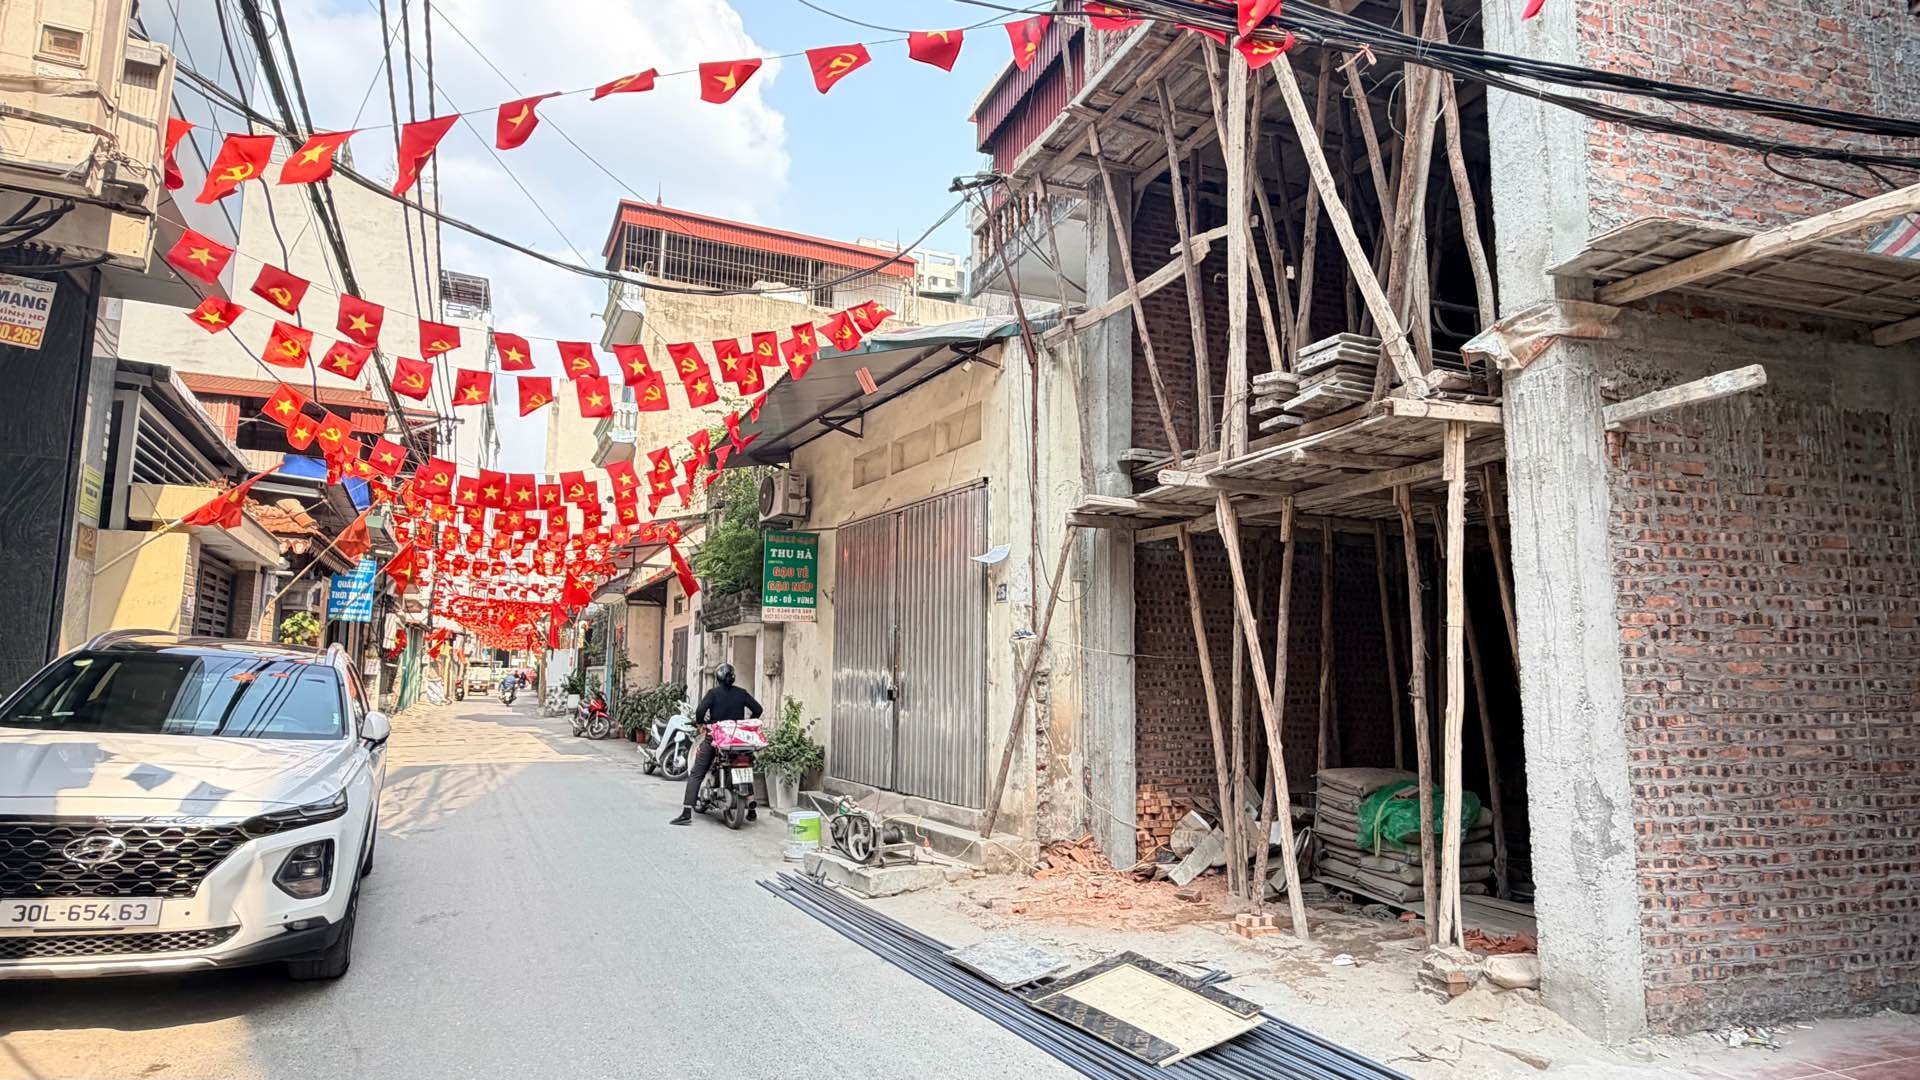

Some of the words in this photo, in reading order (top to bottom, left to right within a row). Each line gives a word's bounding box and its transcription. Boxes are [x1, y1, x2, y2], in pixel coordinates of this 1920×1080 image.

[0, 324, 41, 346] 0.262
[770, 548, 794, 558] THU
[11, 903, 147, 922] 30L-654.63
